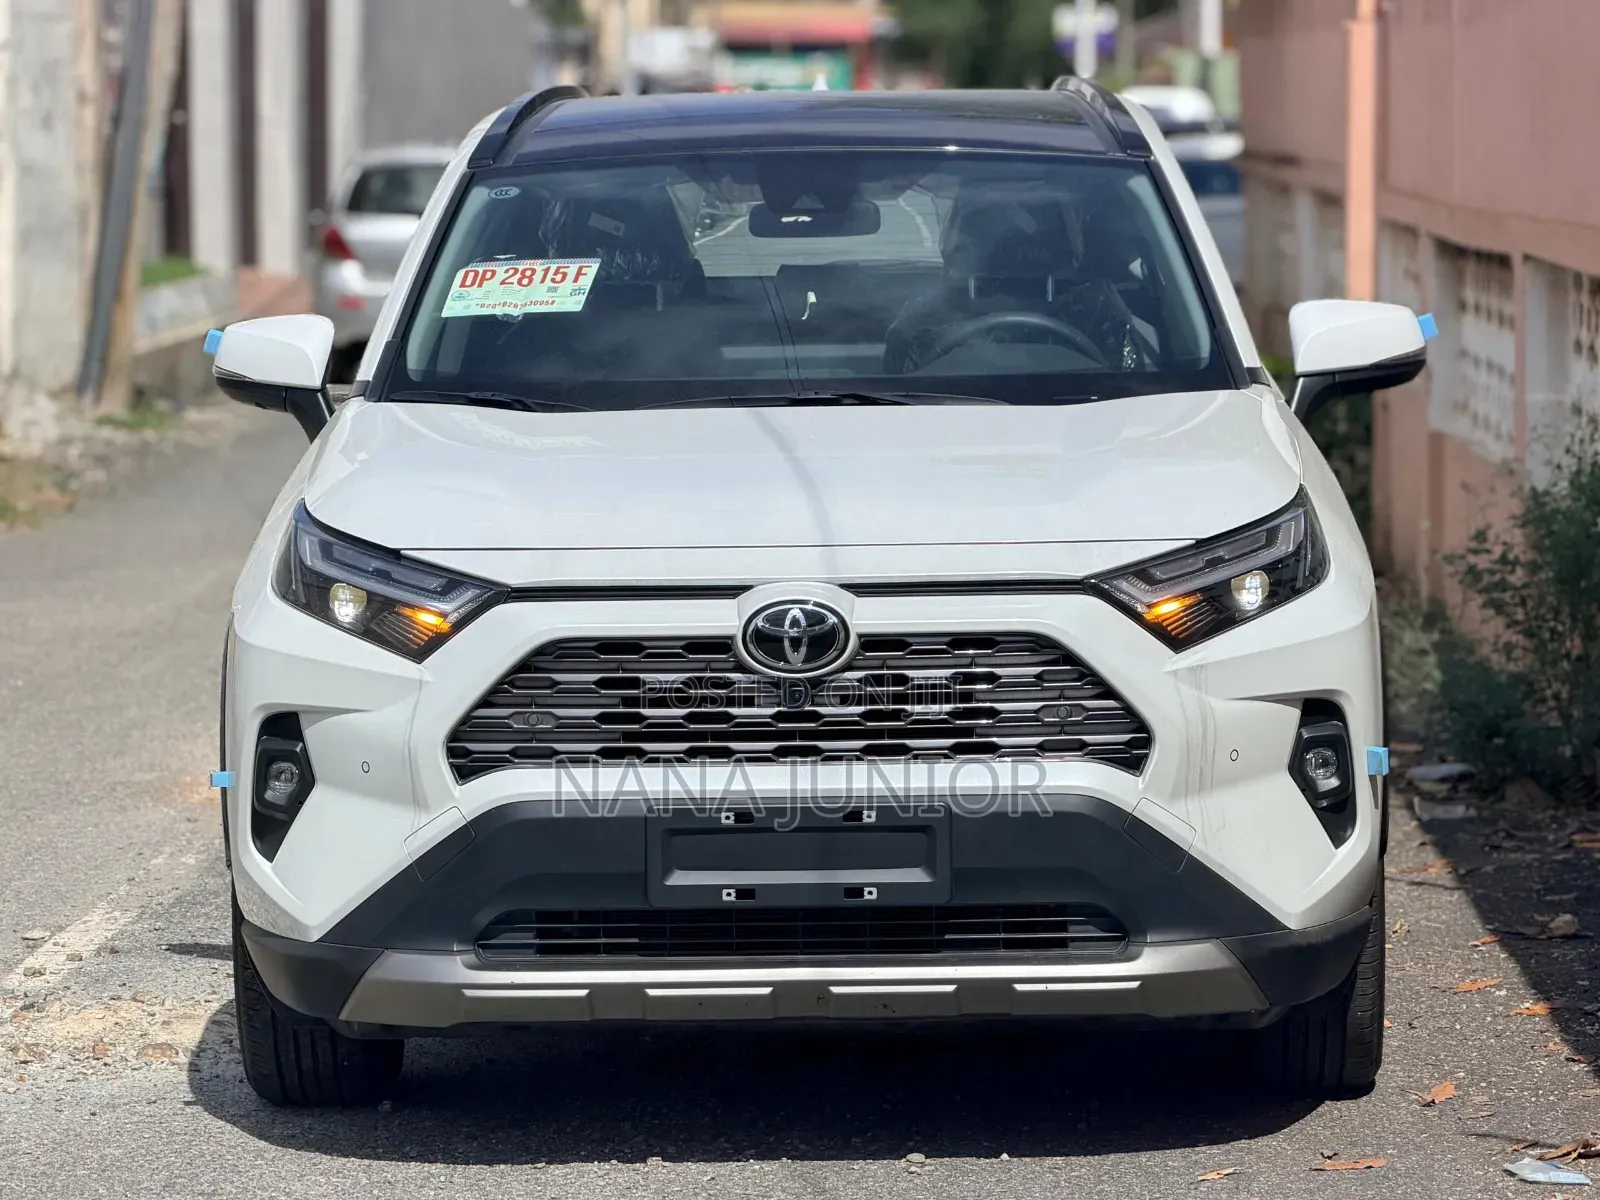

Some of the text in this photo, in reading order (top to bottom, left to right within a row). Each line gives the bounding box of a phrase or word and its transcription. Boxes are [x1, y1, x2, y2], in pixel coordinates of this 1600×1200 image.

[459, 265, 593, 289] DP 2815 F
